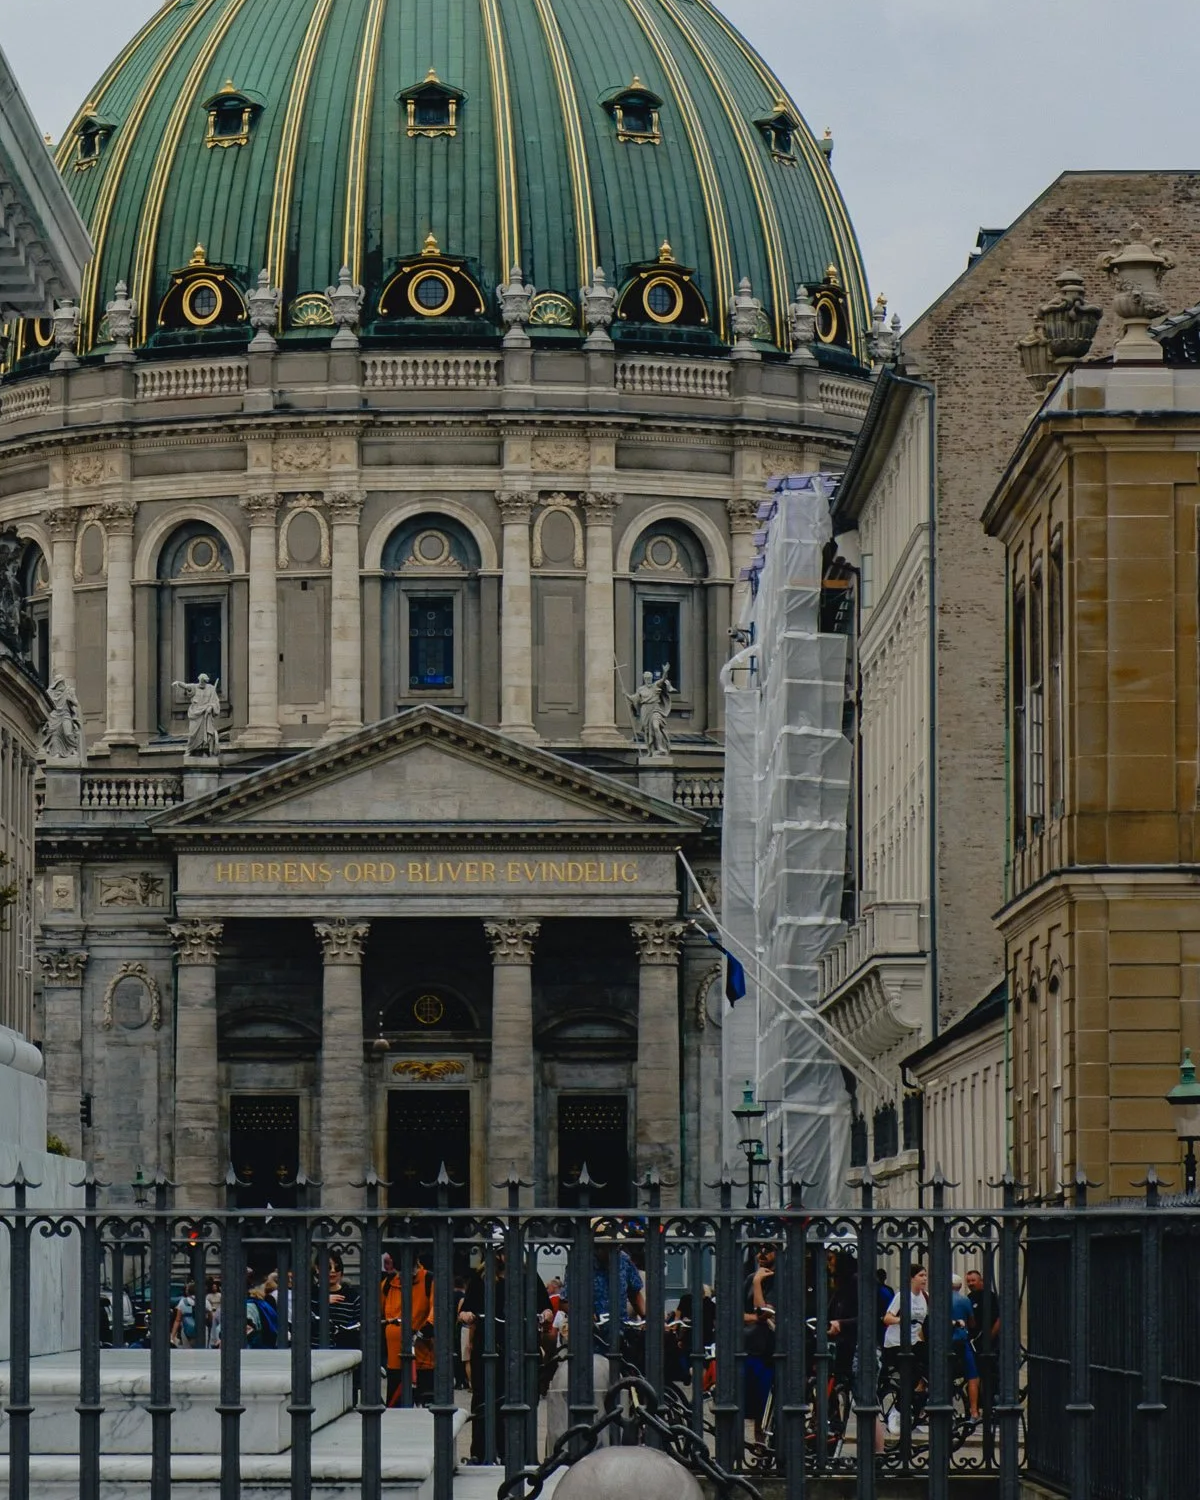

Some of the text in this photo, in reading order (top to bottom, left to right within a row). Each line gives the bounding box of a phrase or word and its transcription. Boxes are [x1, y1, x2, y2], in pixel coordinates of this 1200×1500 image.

[216, 862, 638, 883] HERRENS ORD BLIVER EVINDELIG
